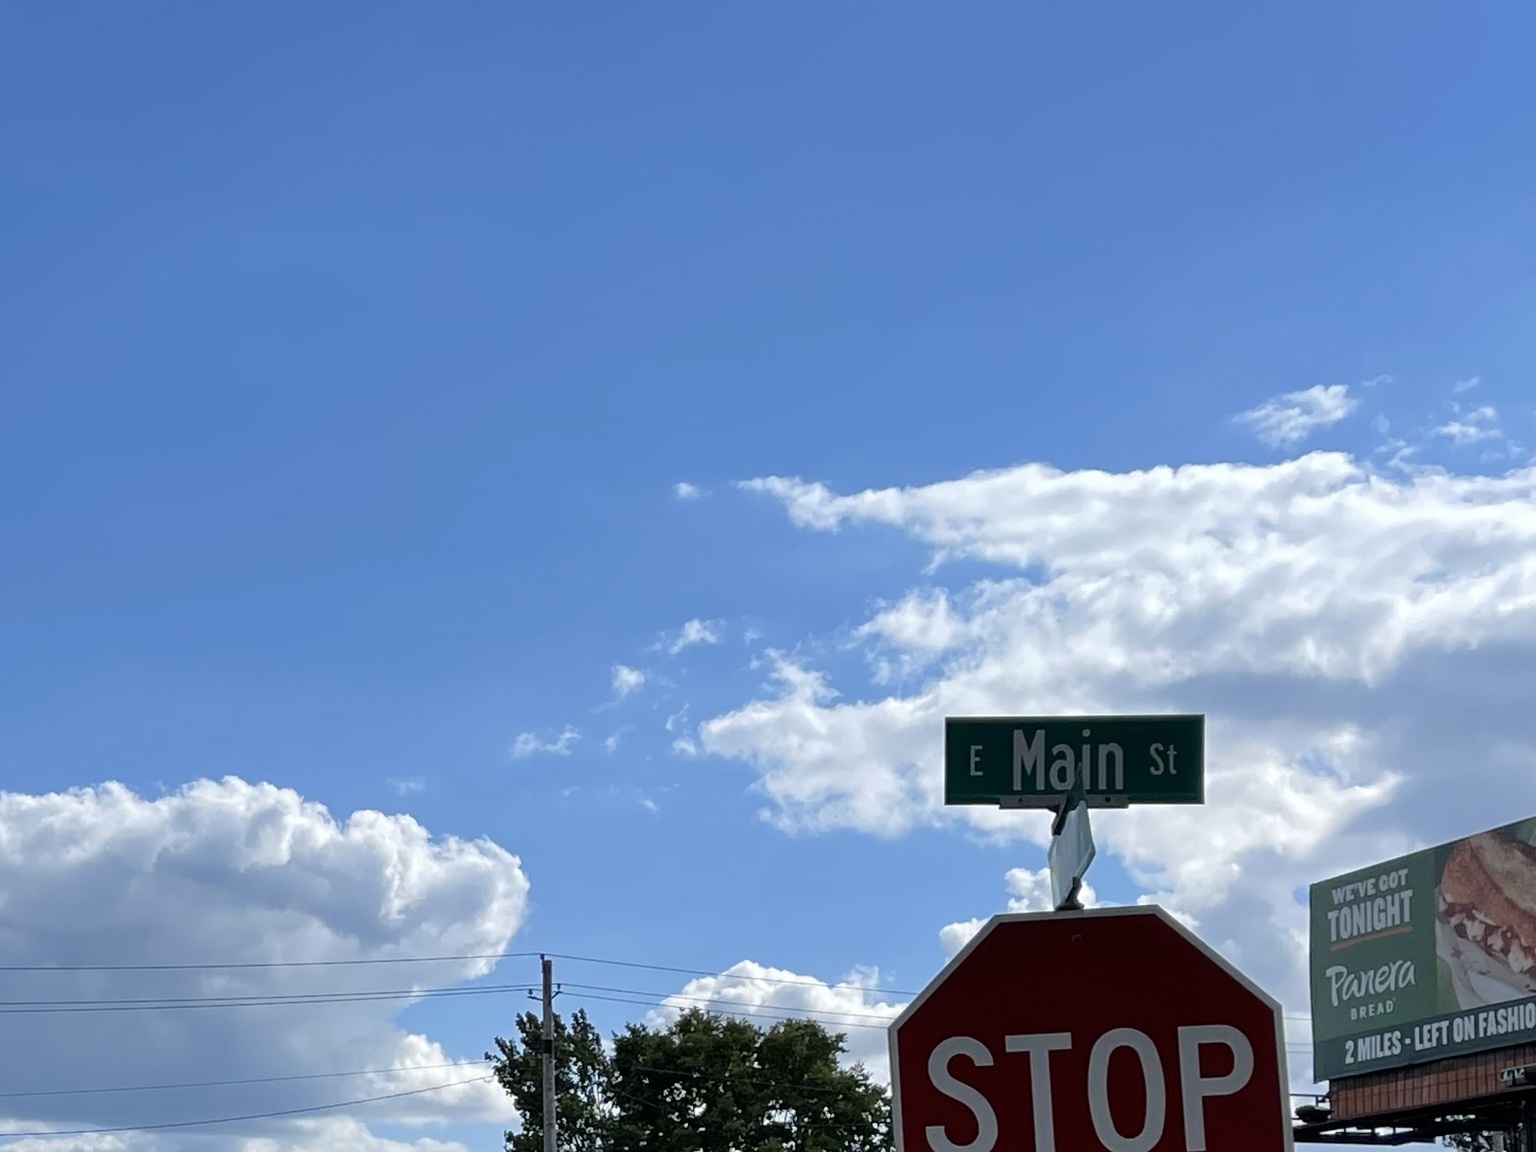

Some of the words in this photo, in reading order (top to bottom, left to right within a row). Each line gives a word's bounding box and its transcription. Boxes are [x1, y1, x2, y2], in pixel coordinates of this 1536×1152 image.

[970, 745, 984, 776] E
[1013, 729, 1125, 791] Main
[1149, 742, 1178, 775] St
[1331, 878, 1376, 905] WE'VE
[1378, 868, 1409, 892] GOT
[1327, 889, 1414, 942] TONIGHT
[1326, 960, 1416, 1007] Panera
[1350, 1000, 1394, 1020] BREAD
[1345, 1040, 1355, 1064] 2
[1357, 1030, 1402, 1062] MILES
[1414, 1020, 1450, 1051] LEFT
[1452, 1015, 1475, 1043] ON
